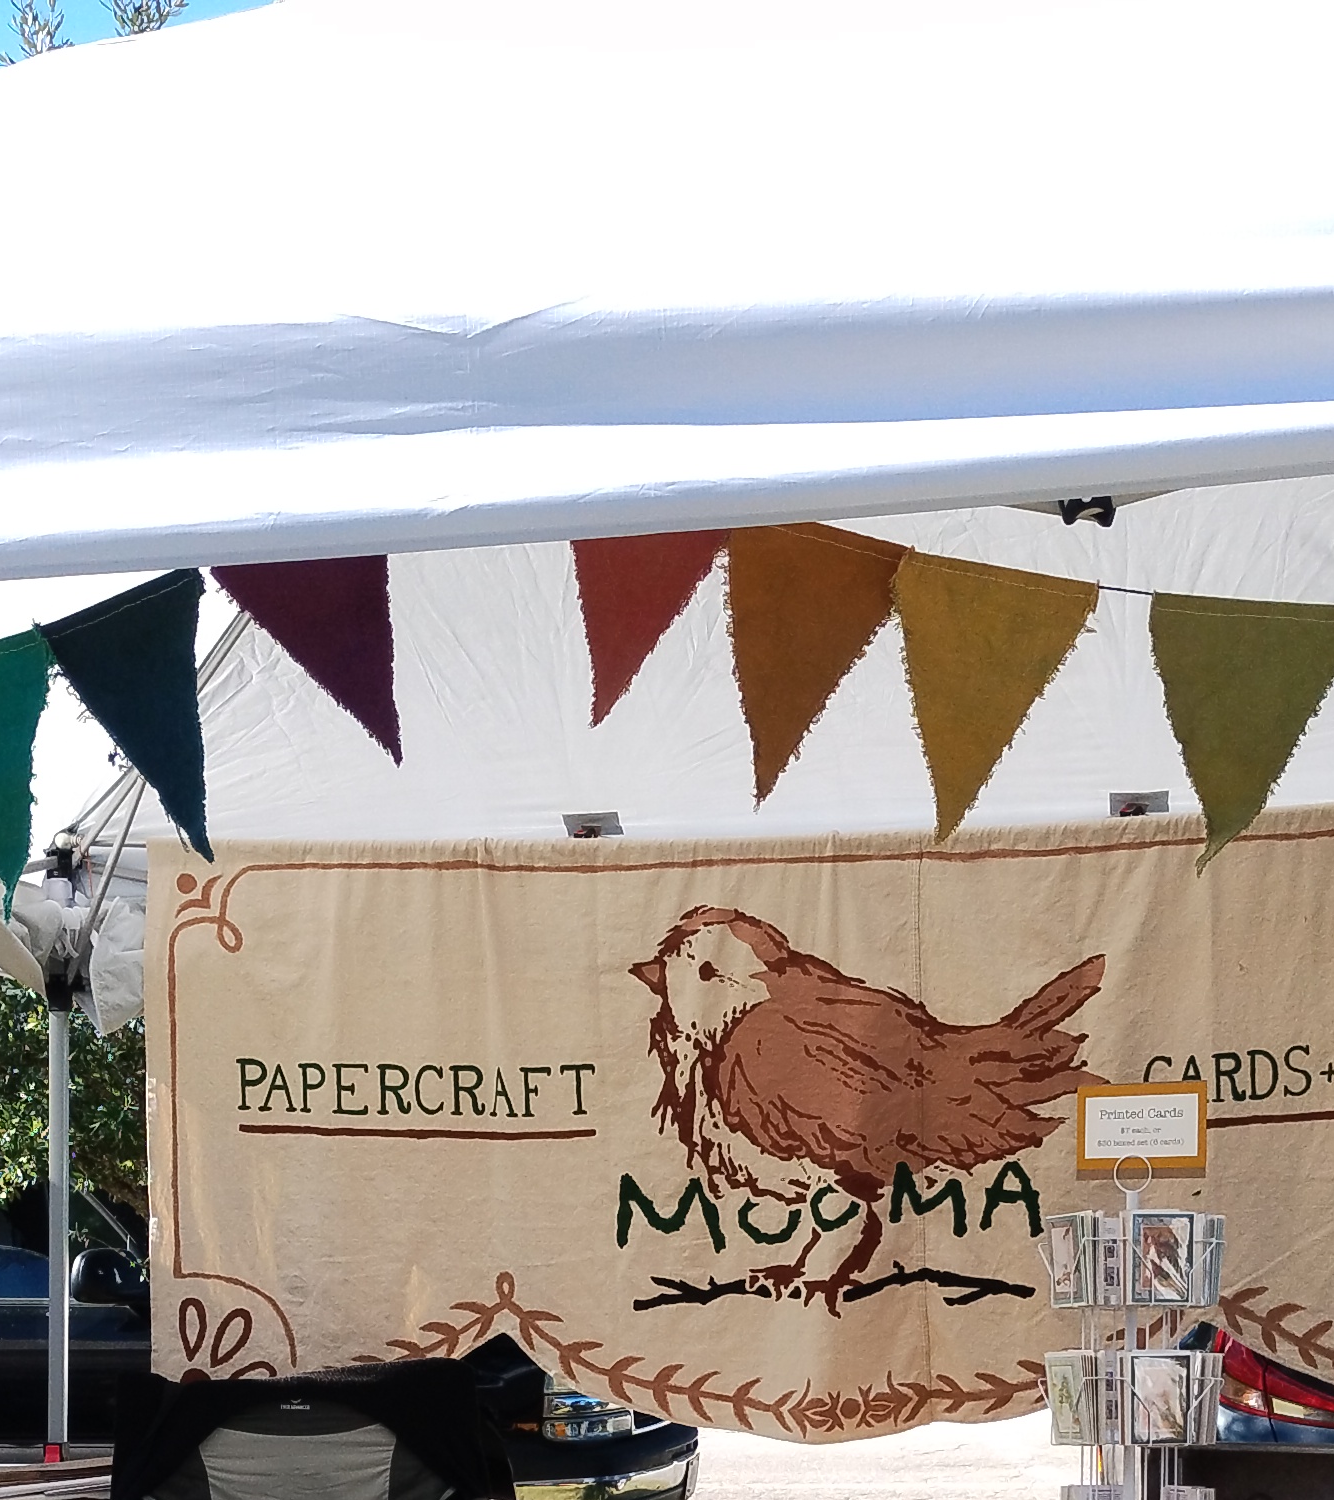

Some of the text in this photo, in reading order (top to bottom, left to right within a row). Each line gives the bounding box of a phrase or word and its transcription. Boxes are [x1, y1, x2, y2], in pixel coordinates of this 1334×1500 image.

[235, 1057, 596, 1118] PAPERCRAFT
[1099, 1107, 1184, 1120] Printed Cards
[617, 1161, 1045, 1253] MOOMA
